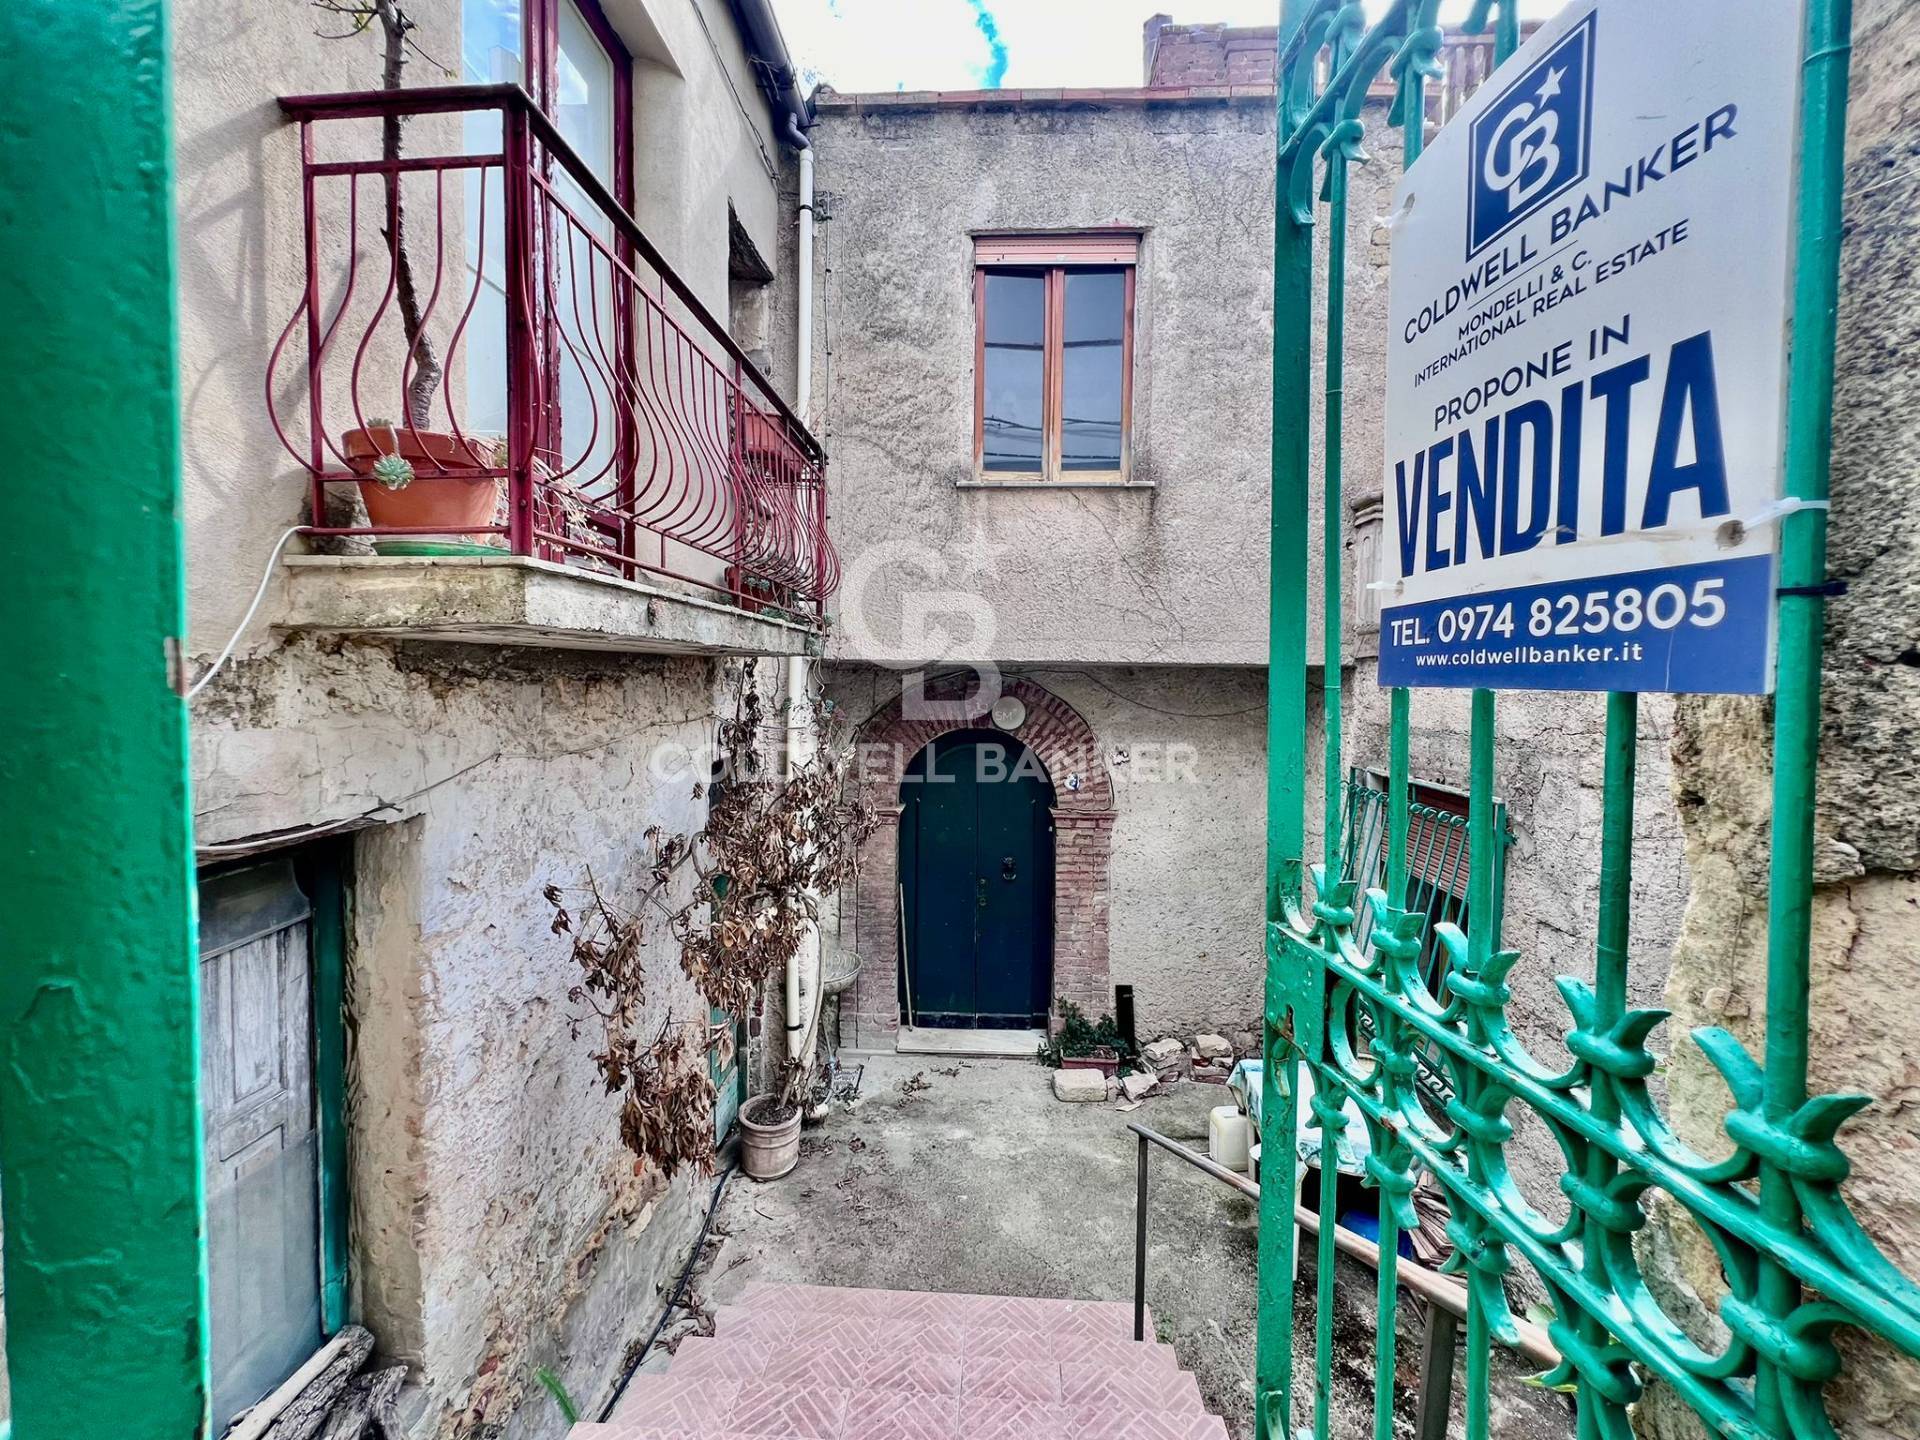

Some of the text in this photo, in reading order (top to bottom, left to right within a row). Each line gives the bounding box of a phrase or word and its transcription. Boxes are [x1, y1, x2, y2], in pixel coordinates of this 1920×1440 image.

[1404, 102, 1738, 344] COLDWELL BANKER
[1414, 218, 1689, 388] INTERNATIONAL REAL ESTATE
[1458, 250, 1592, 340] MONDELLI & C.
[1434, 313, 1630, 431] PROPONE IN
[1395, 329, 1730, 578] VENDITA
[1391, 578, 1726, 647] TEL. 0974 825805
[1416, 642, 1643, 667] www.coldwellbanker.it
